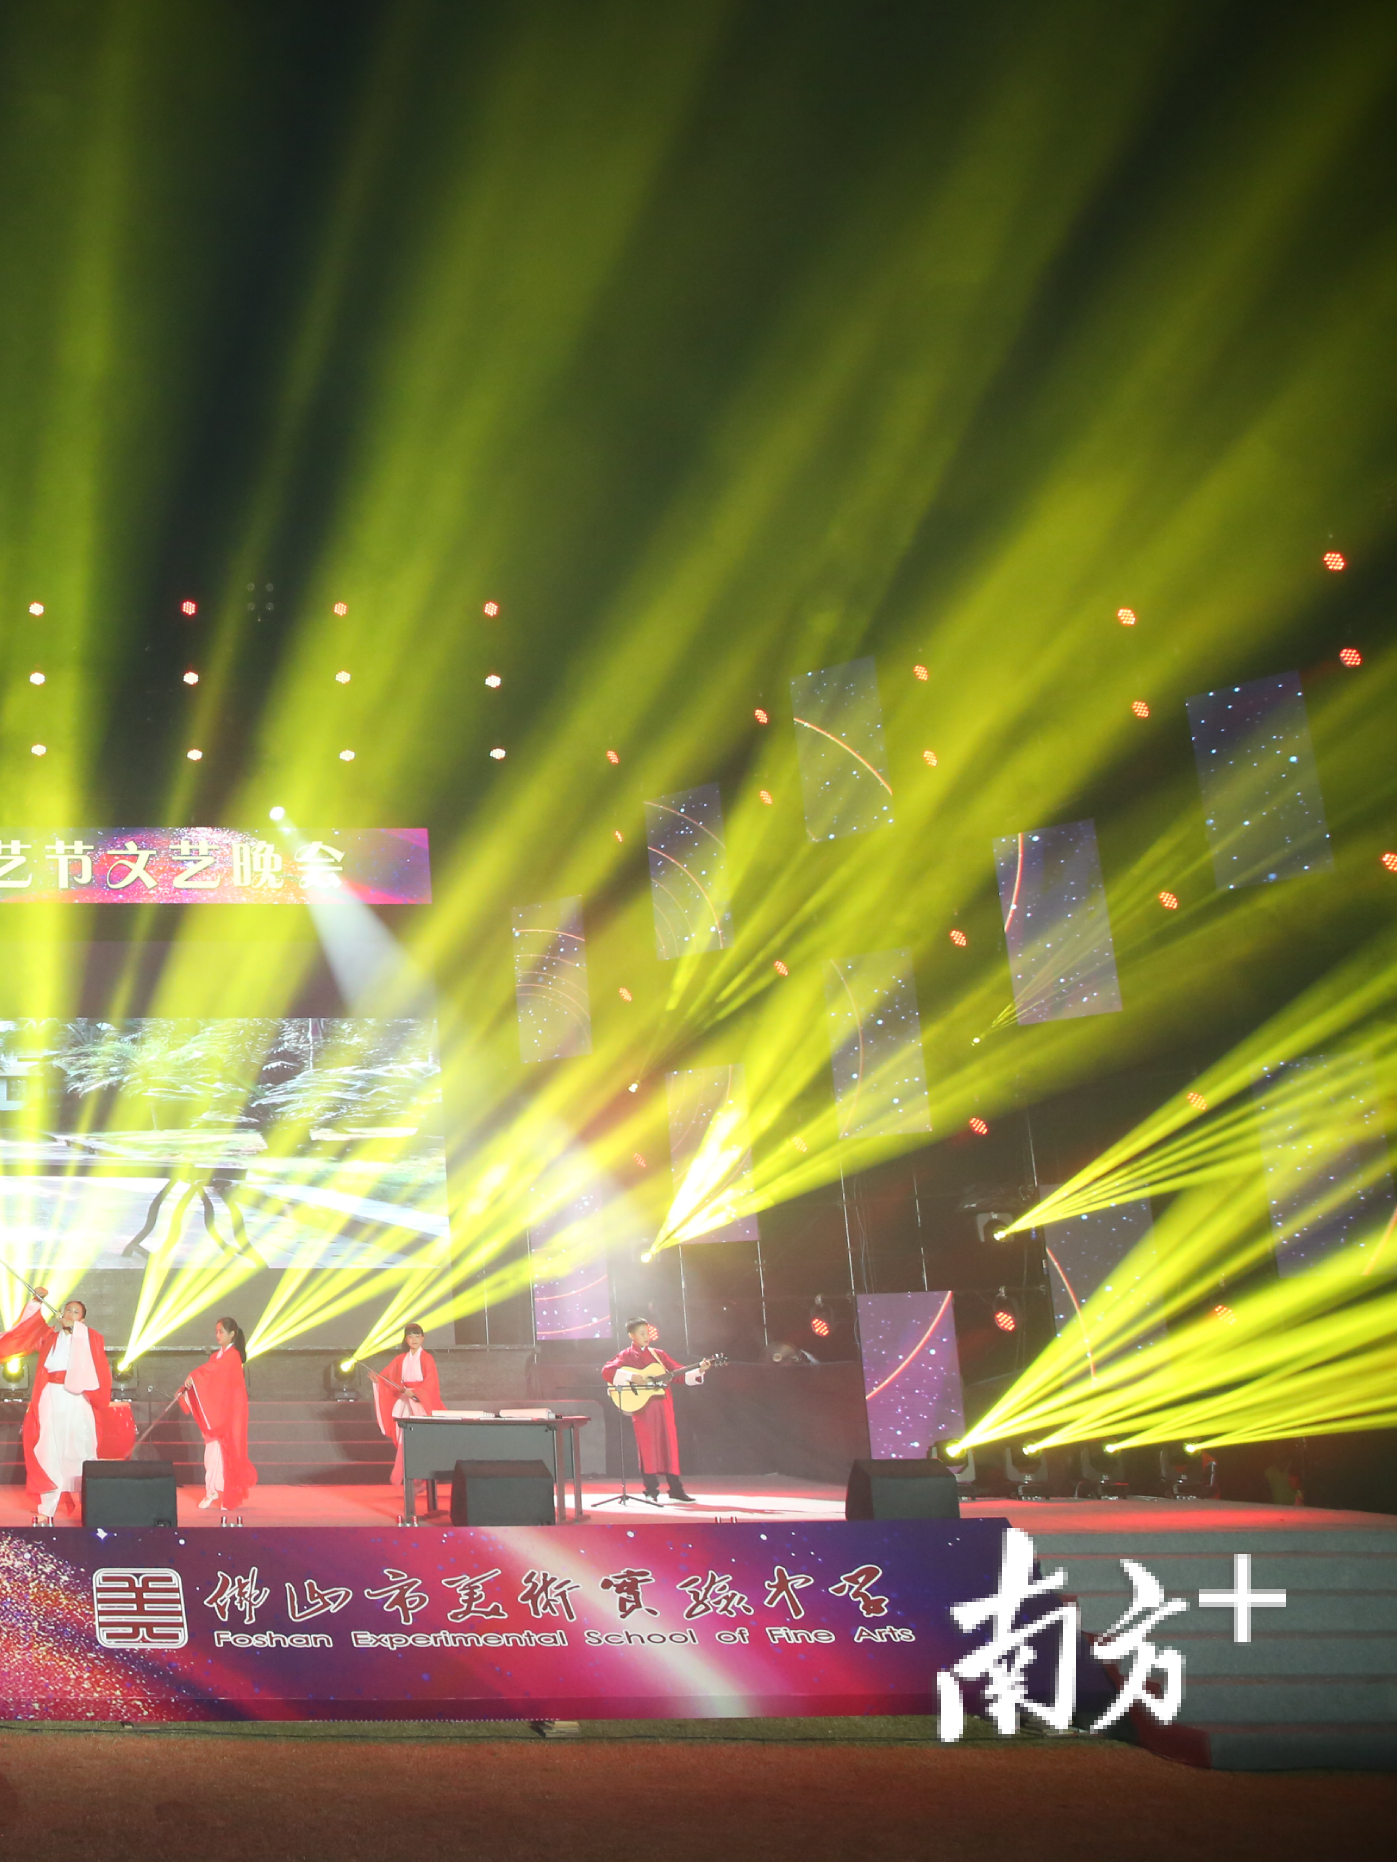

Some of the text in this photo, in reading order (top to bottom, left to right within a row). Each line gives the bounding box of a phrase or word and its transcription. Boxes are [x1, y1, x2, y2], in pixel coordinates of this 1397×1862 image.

[214, 1625, 916, 1651] Foshan Experimental School of Fine Arts
